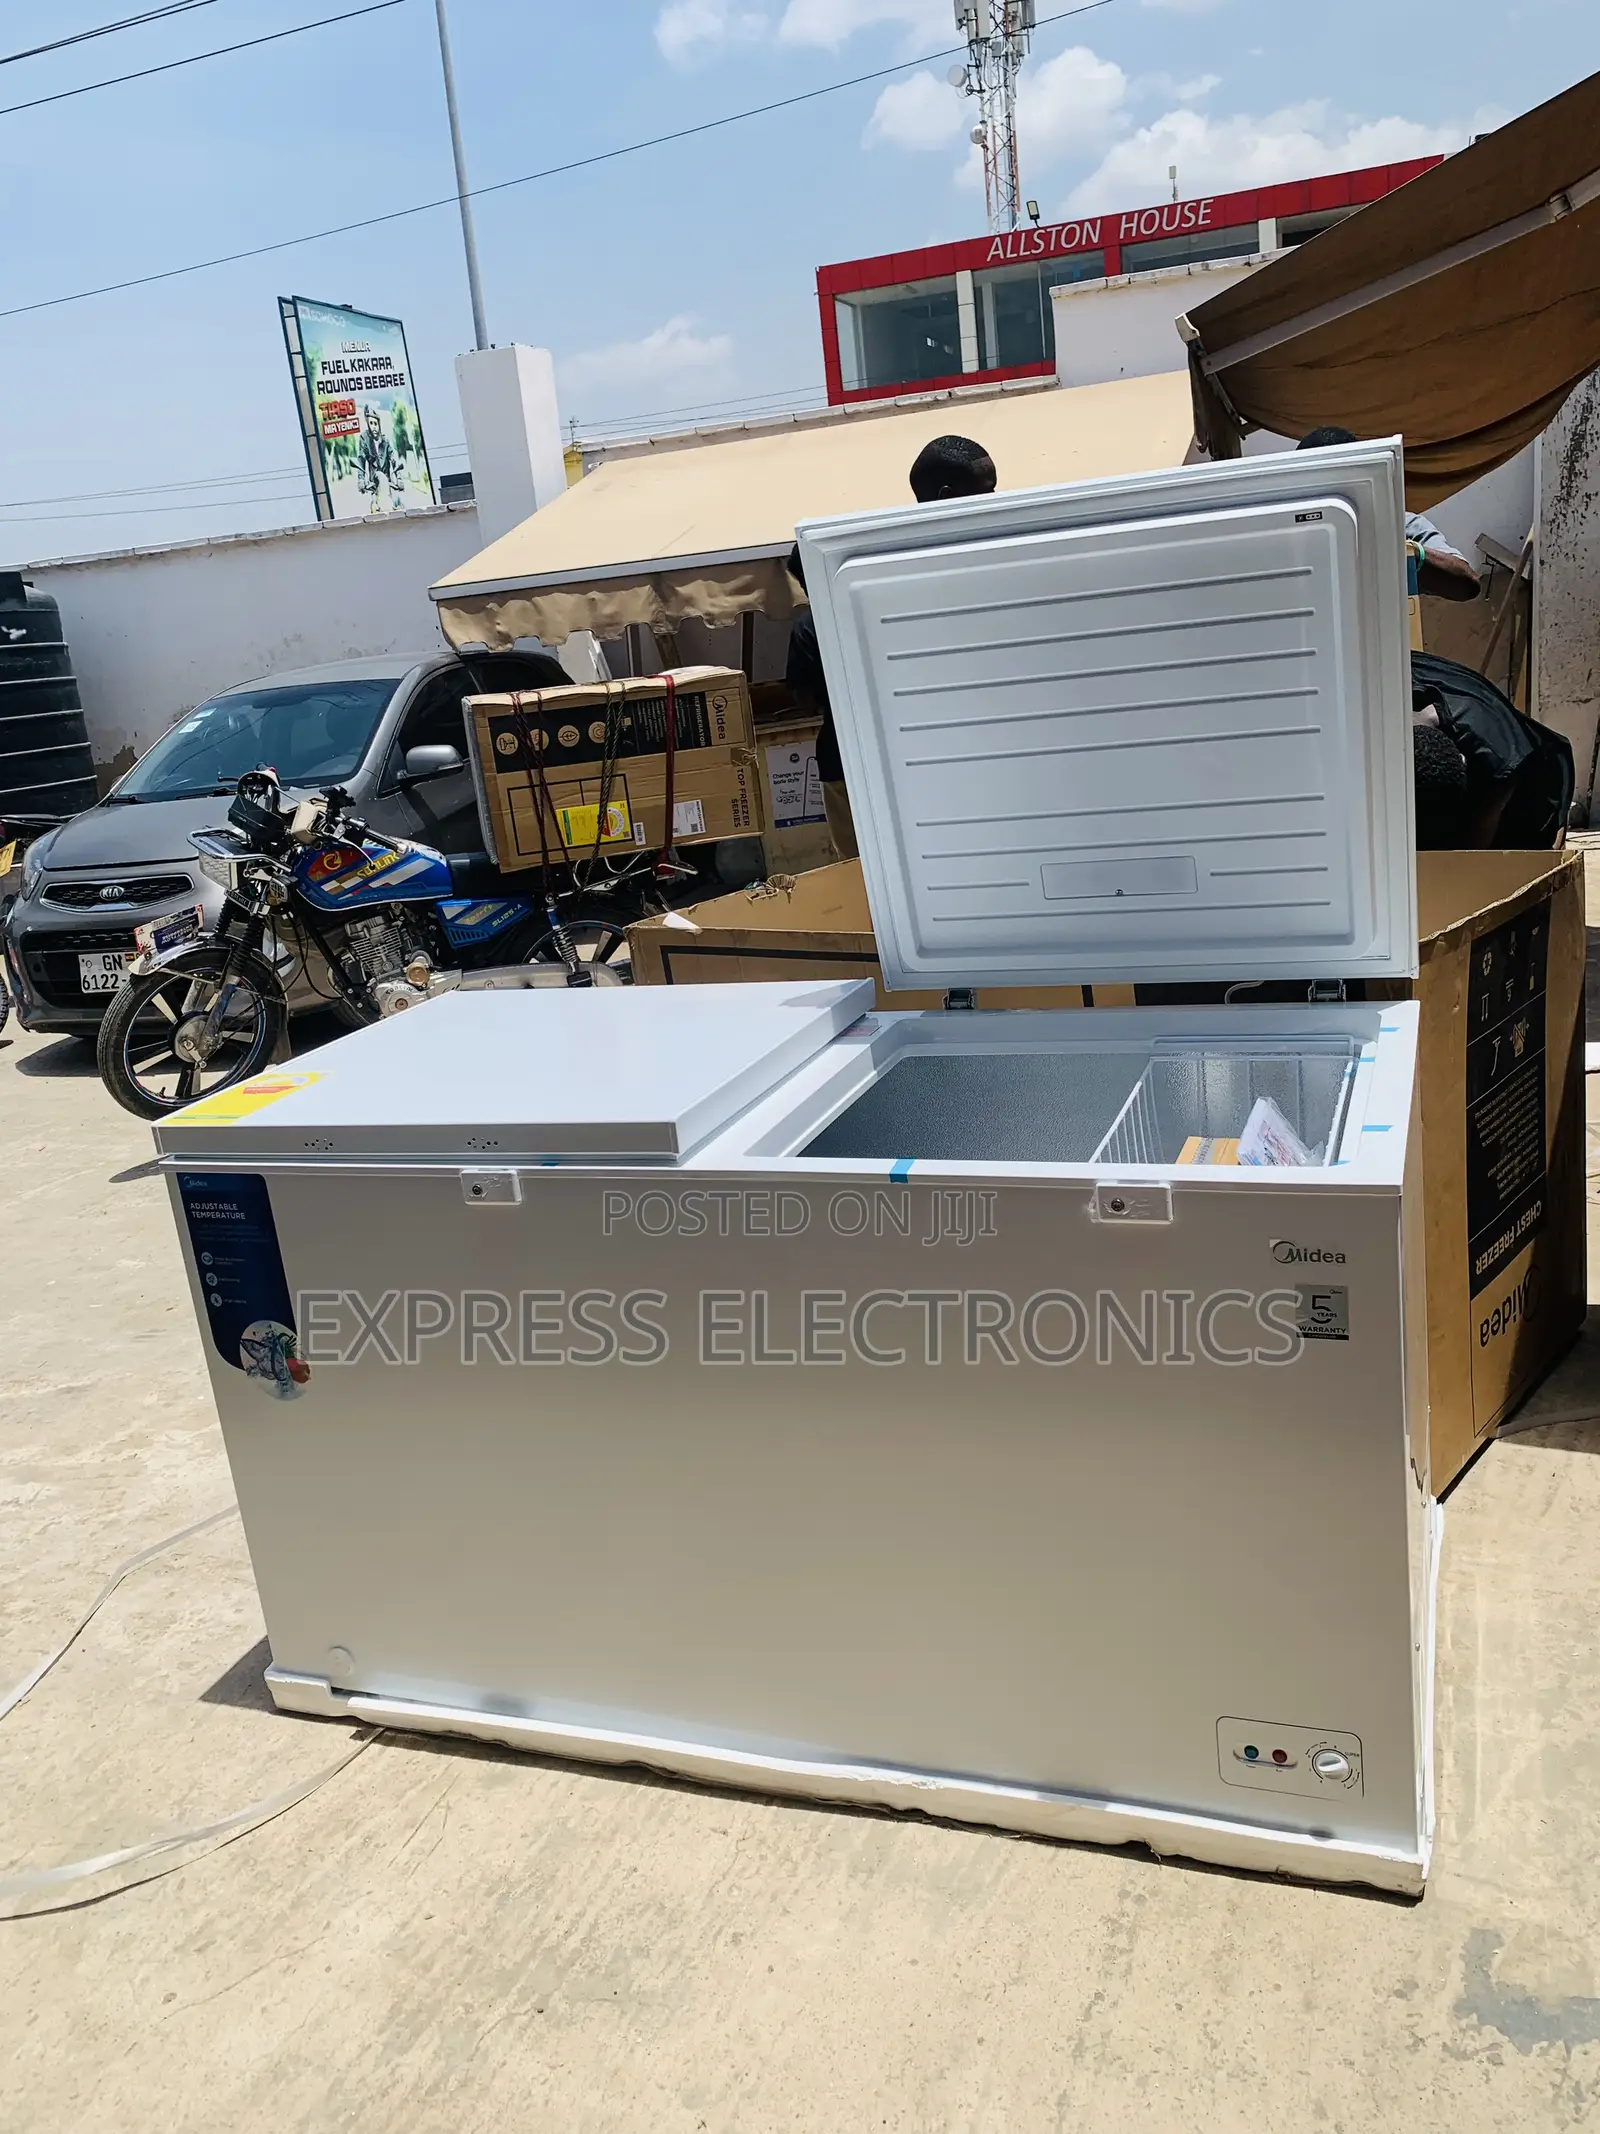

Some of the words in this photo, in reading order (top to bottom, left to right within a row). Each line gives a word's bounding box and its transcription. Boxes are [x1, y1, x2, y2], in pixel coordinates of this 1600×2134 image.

[986, 219, 1101, 262] ALLSTON
[1118, 199, 1214, 240] HOUSE
[321, 360, 350, 375] FUEL
[317, 377, 363, 395] ROUNDS
[364, 373, 405, 389] BEBREE
[712, 696, 728, 740] Midea
[736, 768, 745, 786] TOP
[731, 799, 741, 828] SERIES
[739, 788, 750, 827] FREEZER
[102, 887, 119, 897] KIA
[102, 954, 123, 971] GN
[190, 1202, 238, 1211] ADJUSTABLE
[192, 1211, 246, 1219] TEMPERATURE
[1516, 1200, 1542, 1238] CHEST
[1272, 1240, 1346, 1264] Midea
[1475, 1225, 1515, 1275] FREEZER
[1310, 1294, 1333, 1324] 5
[1479, 1264, 1541, 1348] Midea
[1300, 1326, 1347, 1334] WARRANTY
